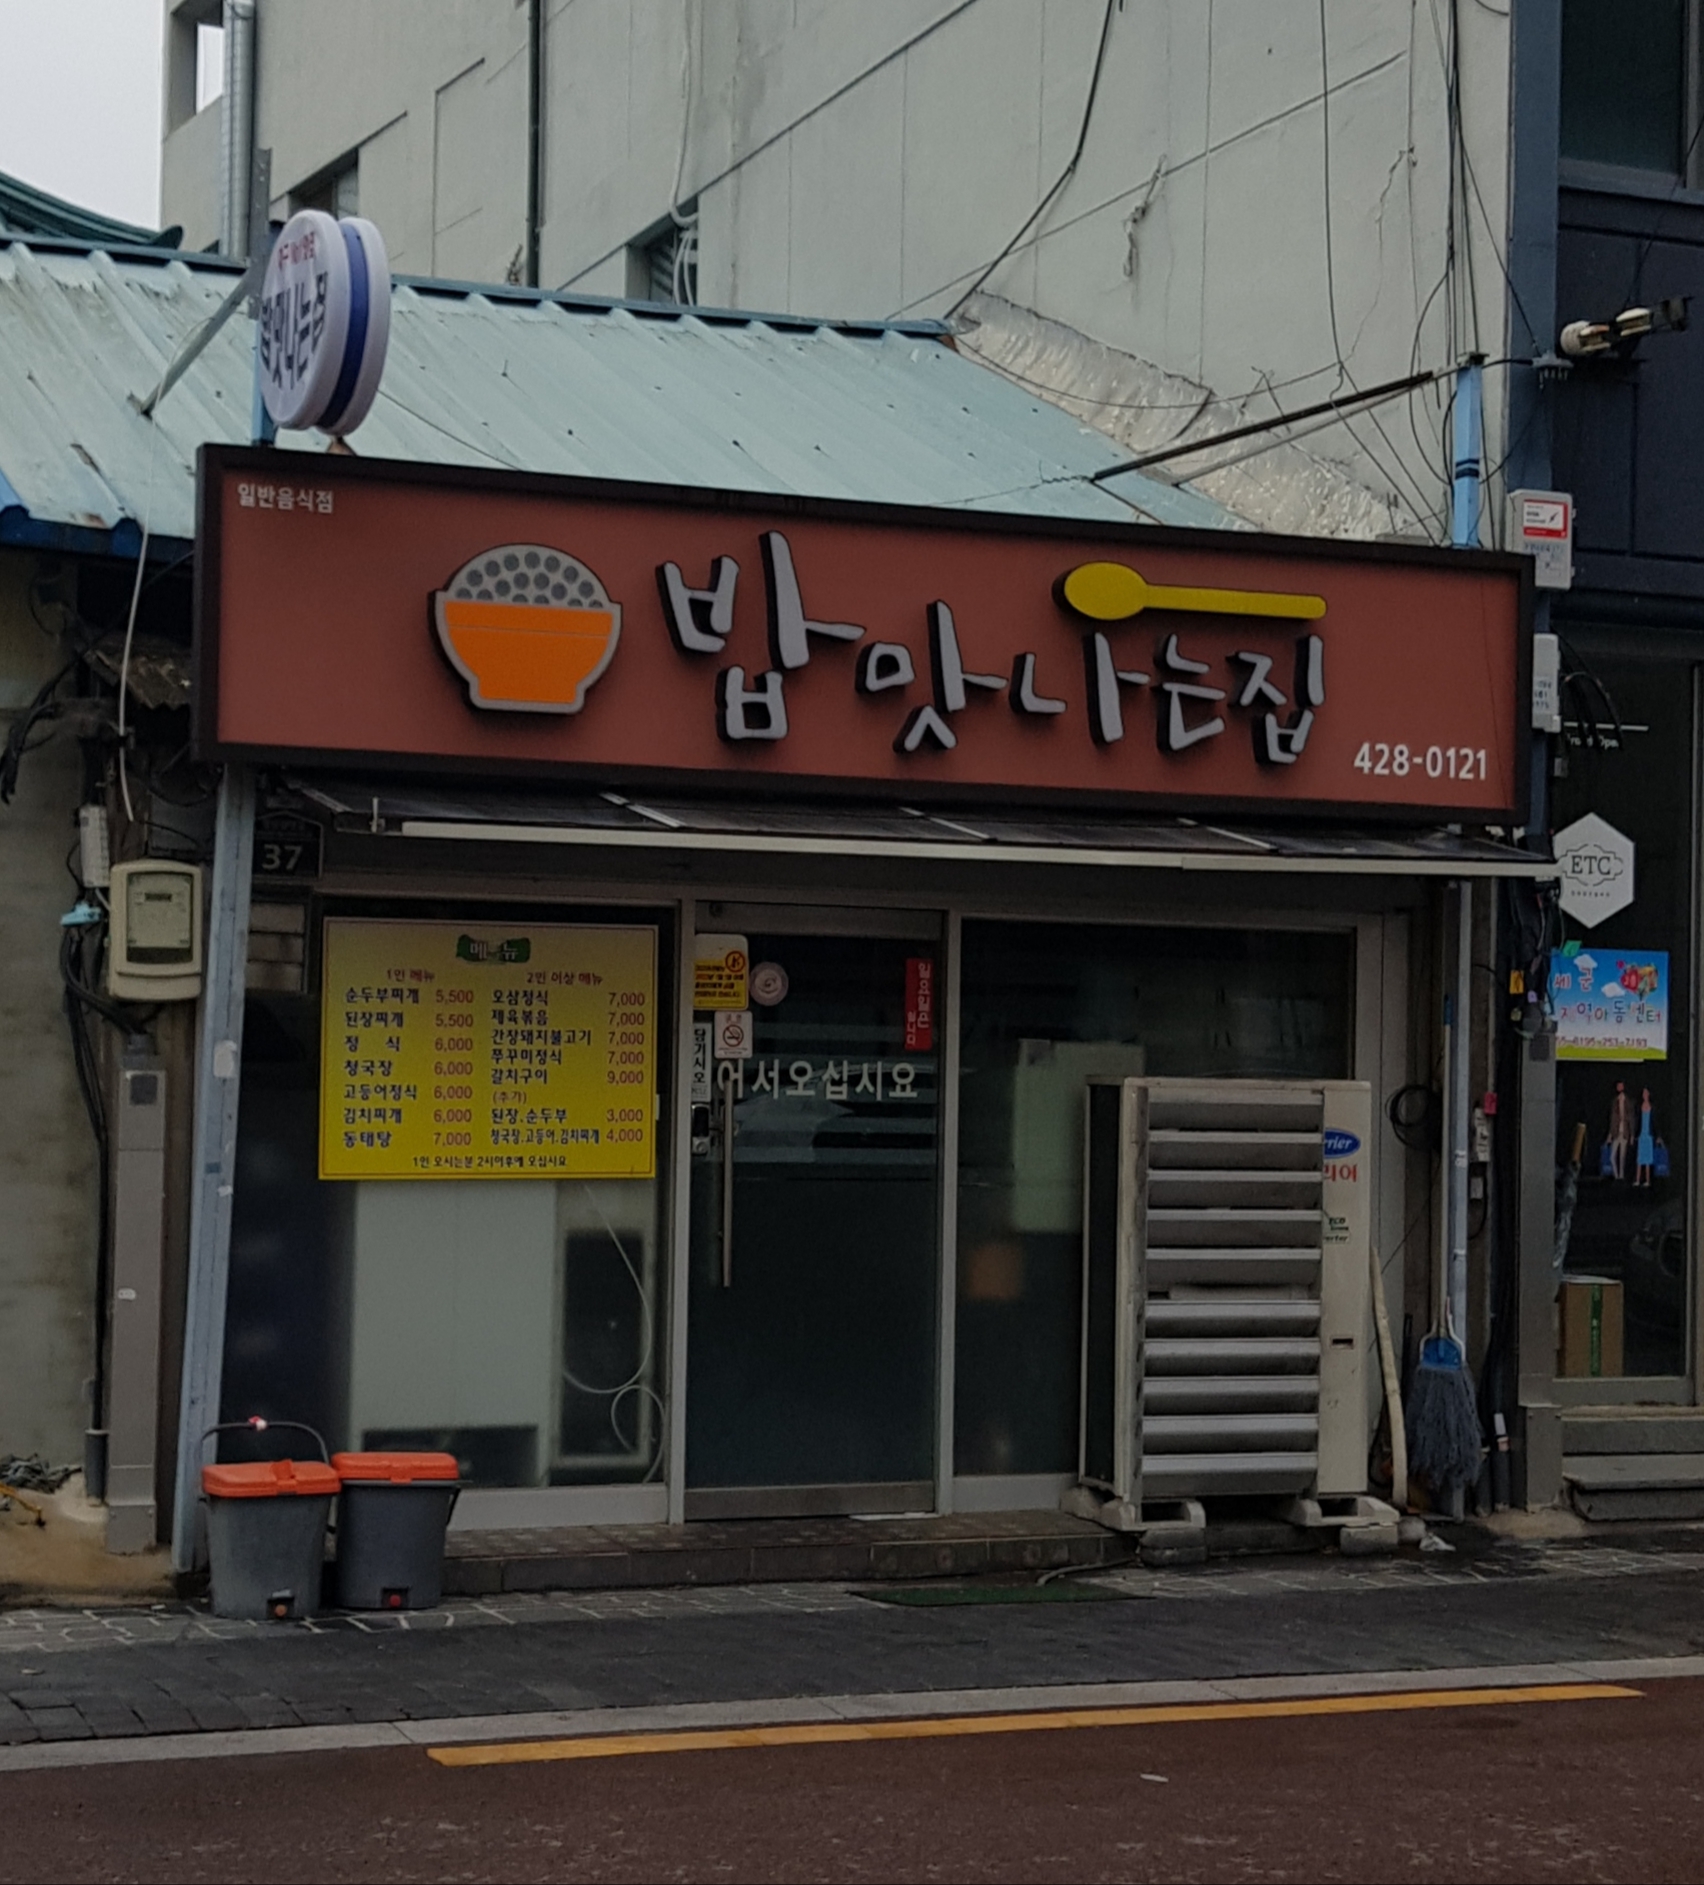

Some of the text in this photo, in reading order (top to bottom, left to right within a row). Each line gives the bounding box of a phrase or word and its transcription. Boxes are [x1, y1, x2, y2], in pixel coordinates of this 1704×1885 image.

[237, 484, 334, 514] 일반음식점
[657, 531, 1326, 765] 밥맛나는집
[1353, 741, 1488, 783] 428-0121
[261, 844, 303, 870] 37
[1571, 855, 1611, 876] ETC
[410, 969, 436, 983] 메뉴
[551, 971, 575, 985] 이상
[578, 972, 604, 986] 메뉴
[345, 987, 474, 1005] 순두부찌개 5,500
[492, 989, 645, 1007] 오삼정식 7,000
[917, 963, 931, 1029] 일요일은
[344, 1011, 474, 1029] 된장찌개 5,500
[491, 1009, 645, 1027] 제육볶음 7,000
[434, 1037, 473, 1053] 6,000
[491, 1029, 645, 1047] 간장돼지불고기 7,000
[607, 1051, 644, 1066] 7,000
[692, 1028, 706, 1084] 당기시오
[344, 1060, 473, 1077] 청국장 6,000
[491, 1068, 644, 1085] 갈치구이 9,000
[717, 1058, 919, 1102] 어서오십시요
[343, 1084, 473, 1101] 고등어정식 6,000
[343, 1107, 472, 1124] 김치찌개 6,000
[606, 1109, 643, 1124] 3,000
[343, 1131, 472, 1148] 동태탕 7,000
[606, 1128, 643, 1143] 4,000
[413, 1156, 430, 1168] 1인
